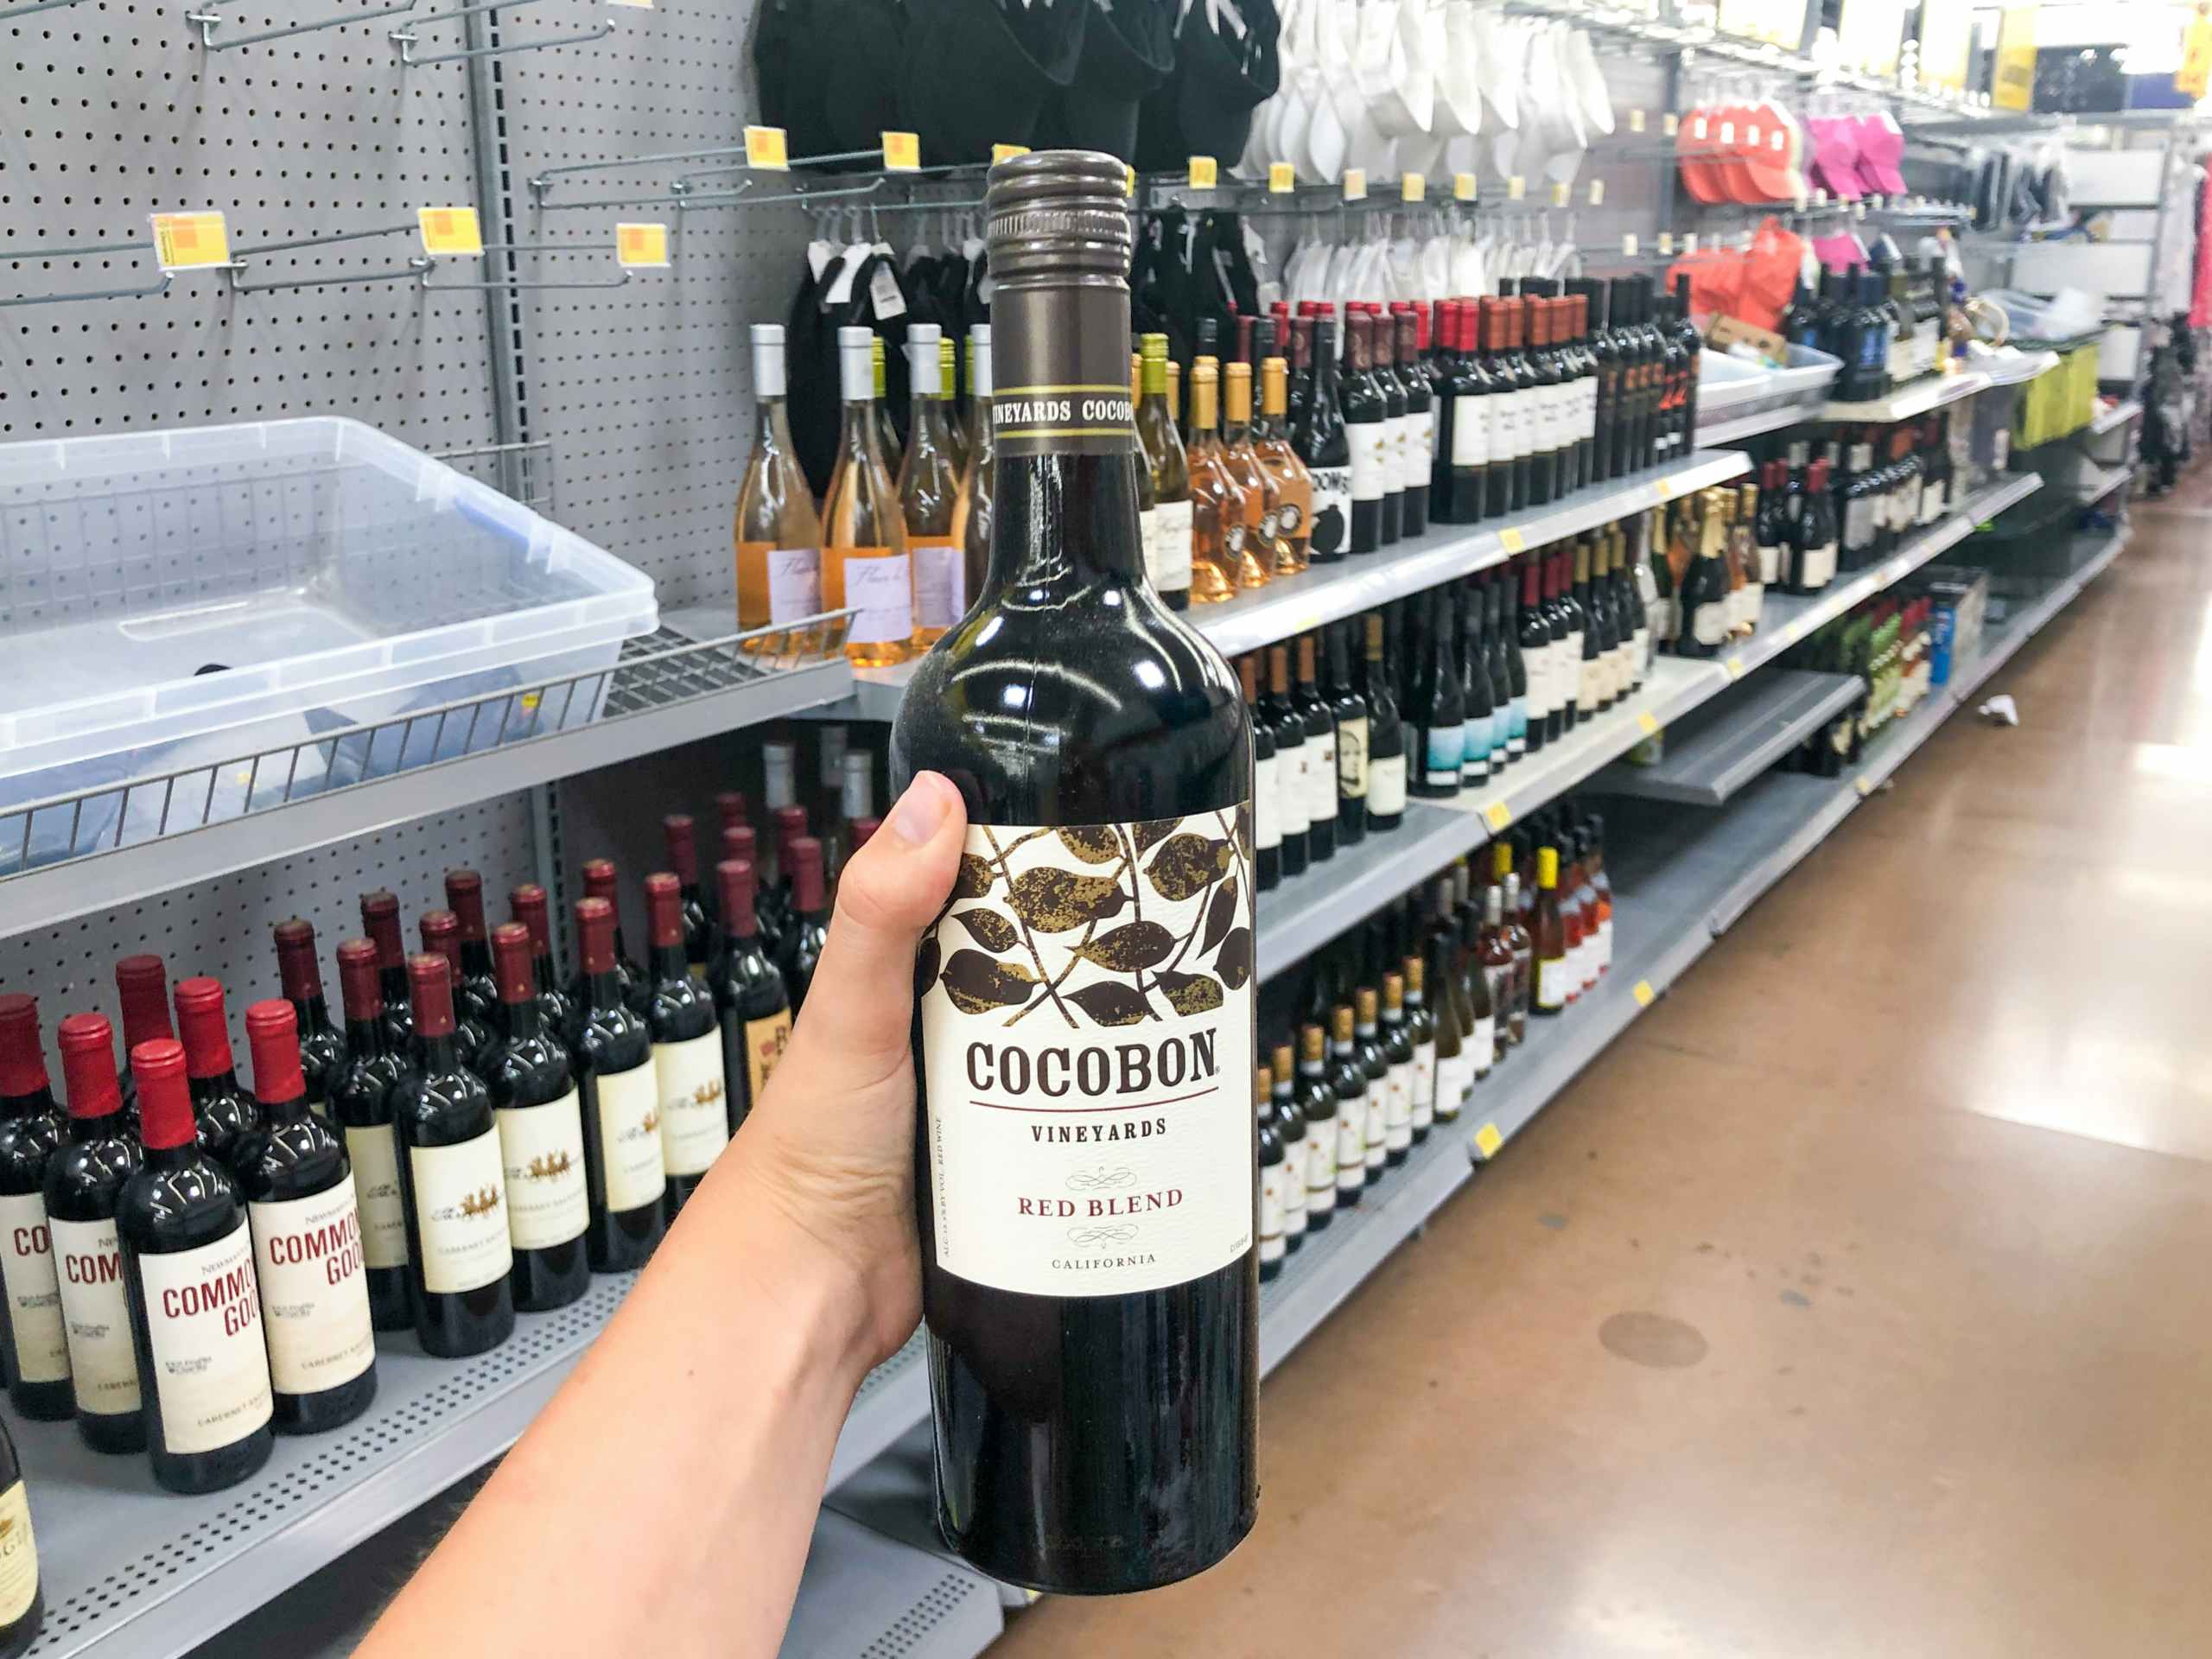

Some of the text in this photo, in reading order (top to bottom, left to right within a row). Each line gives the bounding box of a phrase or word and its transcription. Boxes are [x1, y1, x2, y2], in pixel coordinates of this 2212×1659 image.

[993, 399, 1134, 424] INEYARDS COCOB
[966, 1027, 1217, 1097] COCOBON
[1032, 1118, 1166, 1142] VINEYARDS
[1018, 1189, 1183, 1217] RED BLEND
[1052, 1254, 1155, 1269] CALIFORNIA
